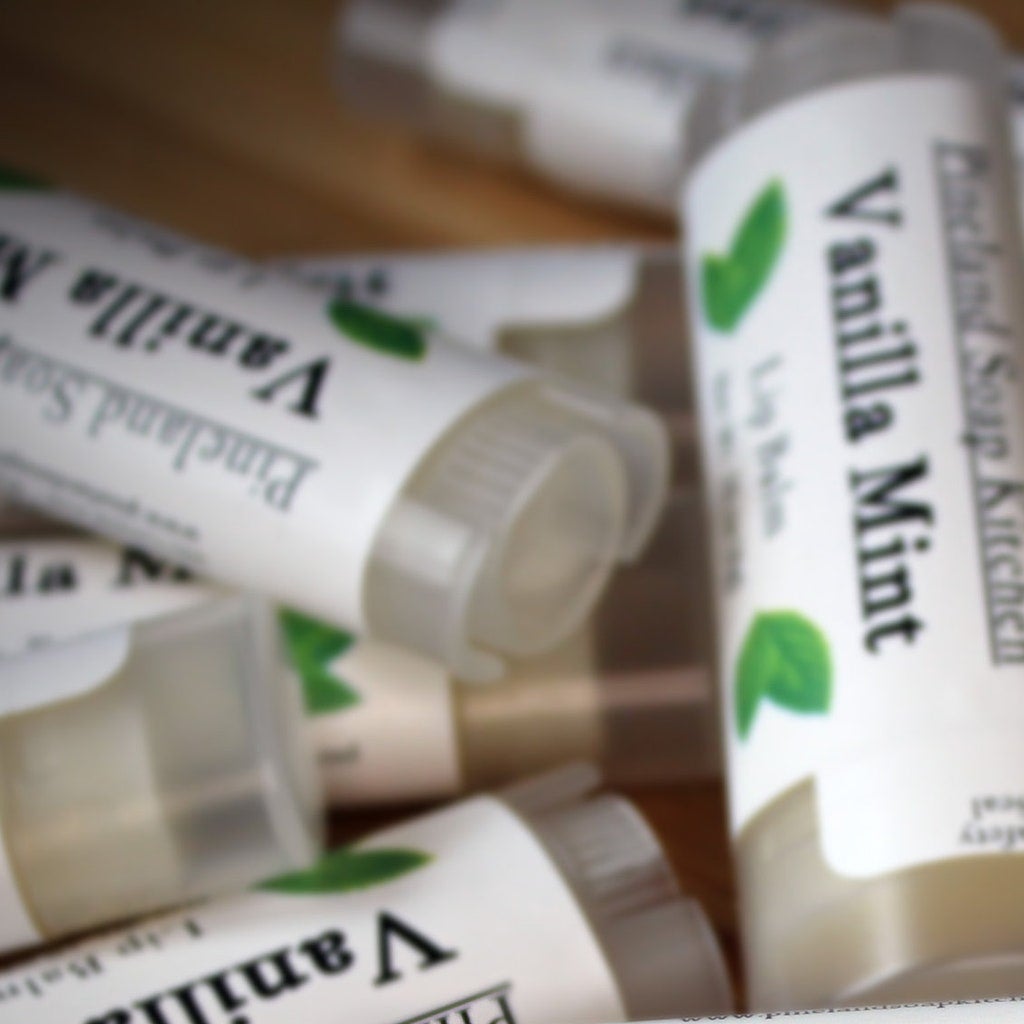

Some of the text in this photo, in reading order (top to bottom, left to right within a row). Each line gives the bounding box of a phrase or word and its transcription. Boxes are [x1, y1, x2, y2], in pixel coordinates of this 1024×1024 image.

[67, 268, 332, 420] Vanilla
[823, 166, 935, 655] Vanilla Mint
[87, 382, 319, 512] Pineland
